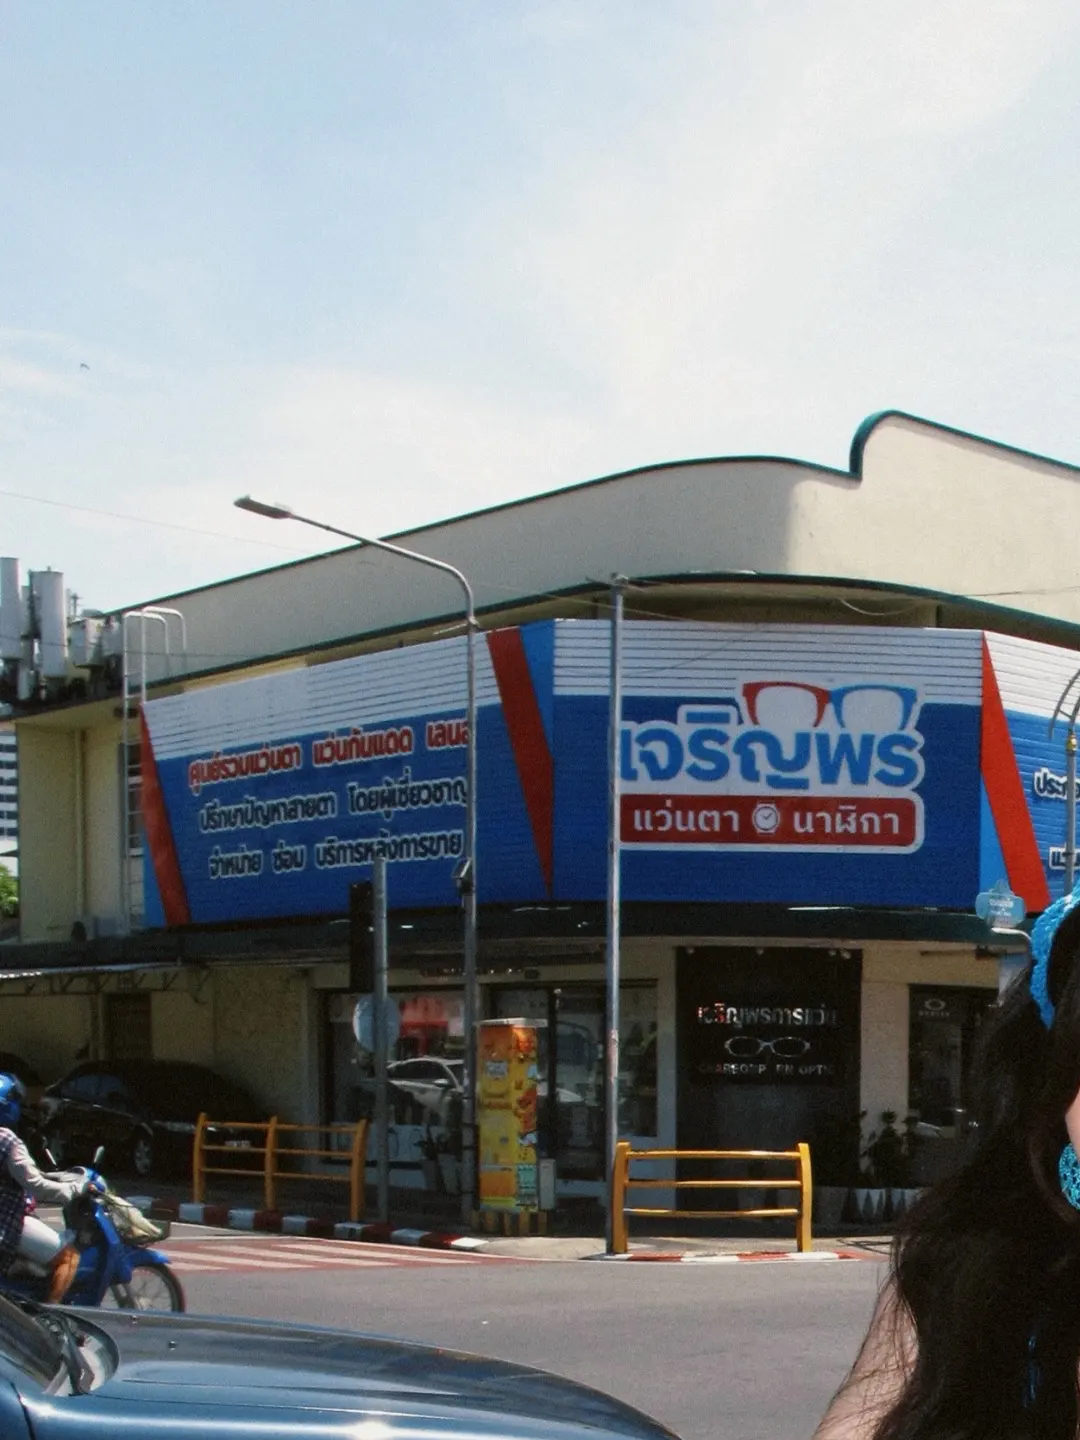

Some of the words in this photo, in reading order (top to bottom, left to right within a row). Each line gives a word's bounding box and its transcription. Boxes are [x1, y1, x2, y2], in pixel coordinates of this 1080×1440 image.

[312, 727, 414, 767] แว่นกันแดด
[620, 711, 920, 790] เจริญพร
[633, 799, 740, 832] แว่นตา
[793, 804, 900, 834] นาฬิกา
